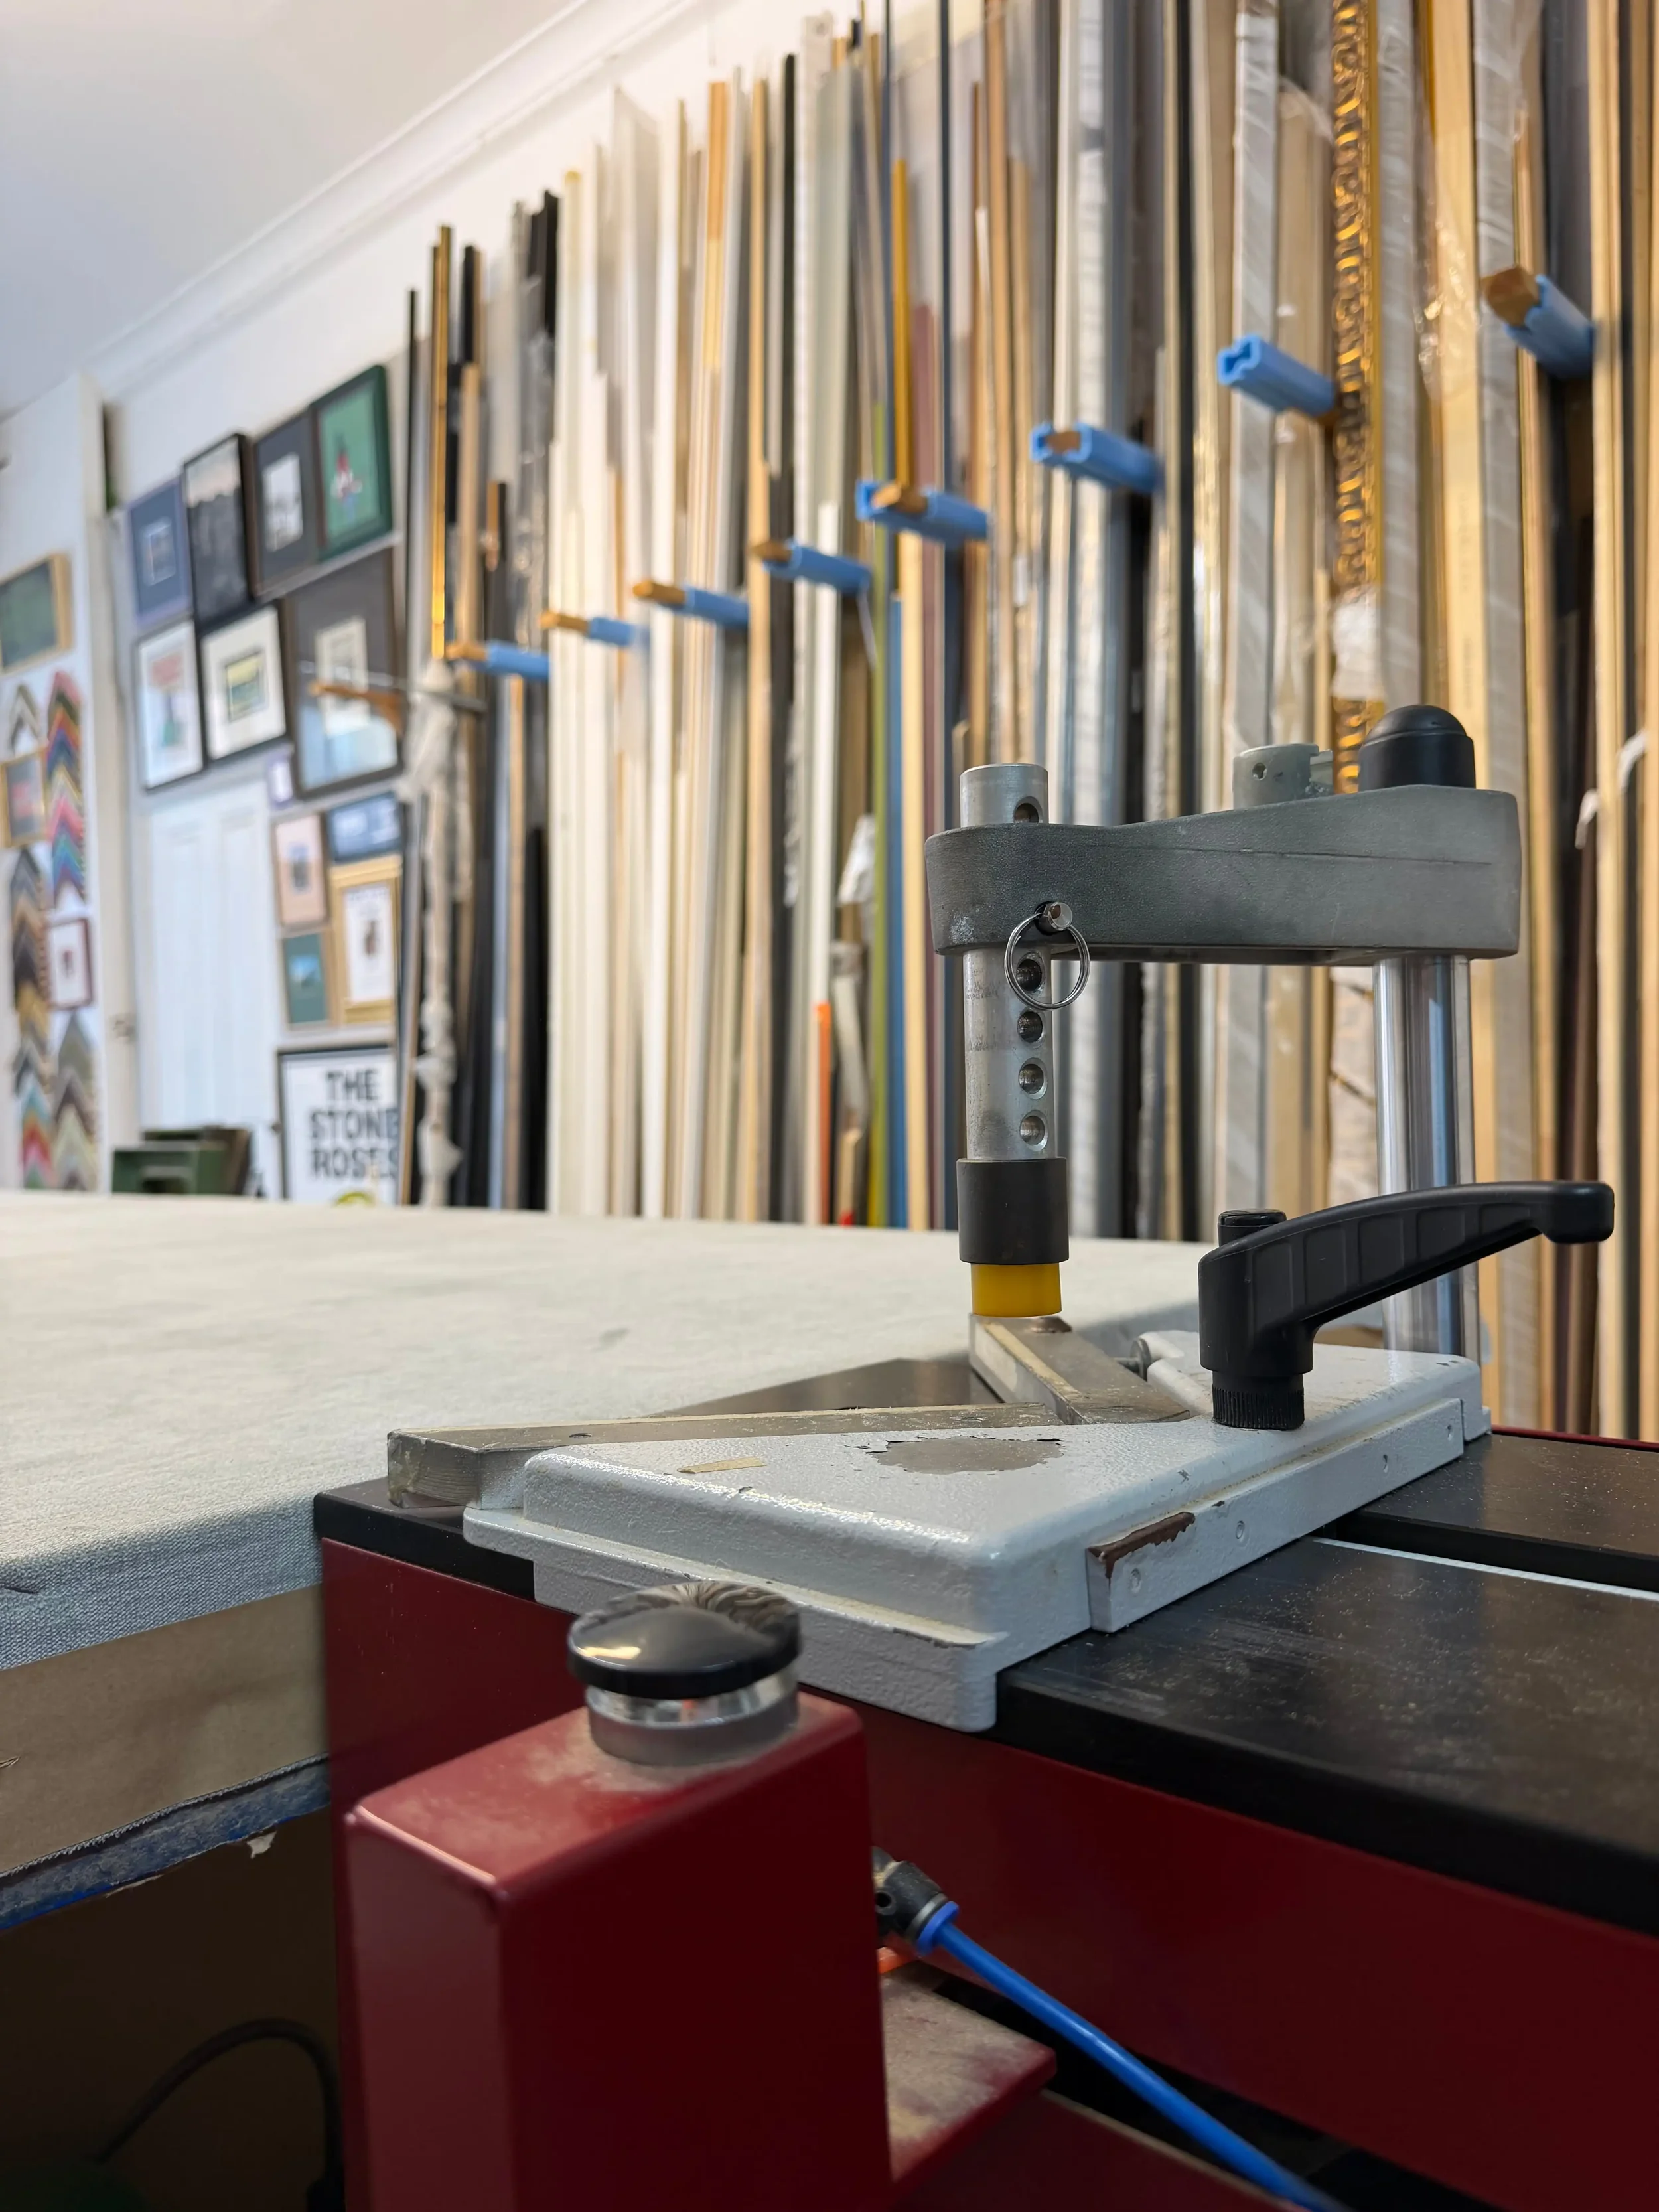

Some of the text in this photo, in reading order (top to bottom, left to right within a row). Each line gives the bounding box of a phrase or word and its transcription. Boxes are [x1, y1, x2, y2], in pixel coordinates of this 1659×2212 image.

[326, 1070, 378, 1100] THE
[311, 1108, 398, 1140] STONE
[312, 1146, 398, 1179] ROSES
